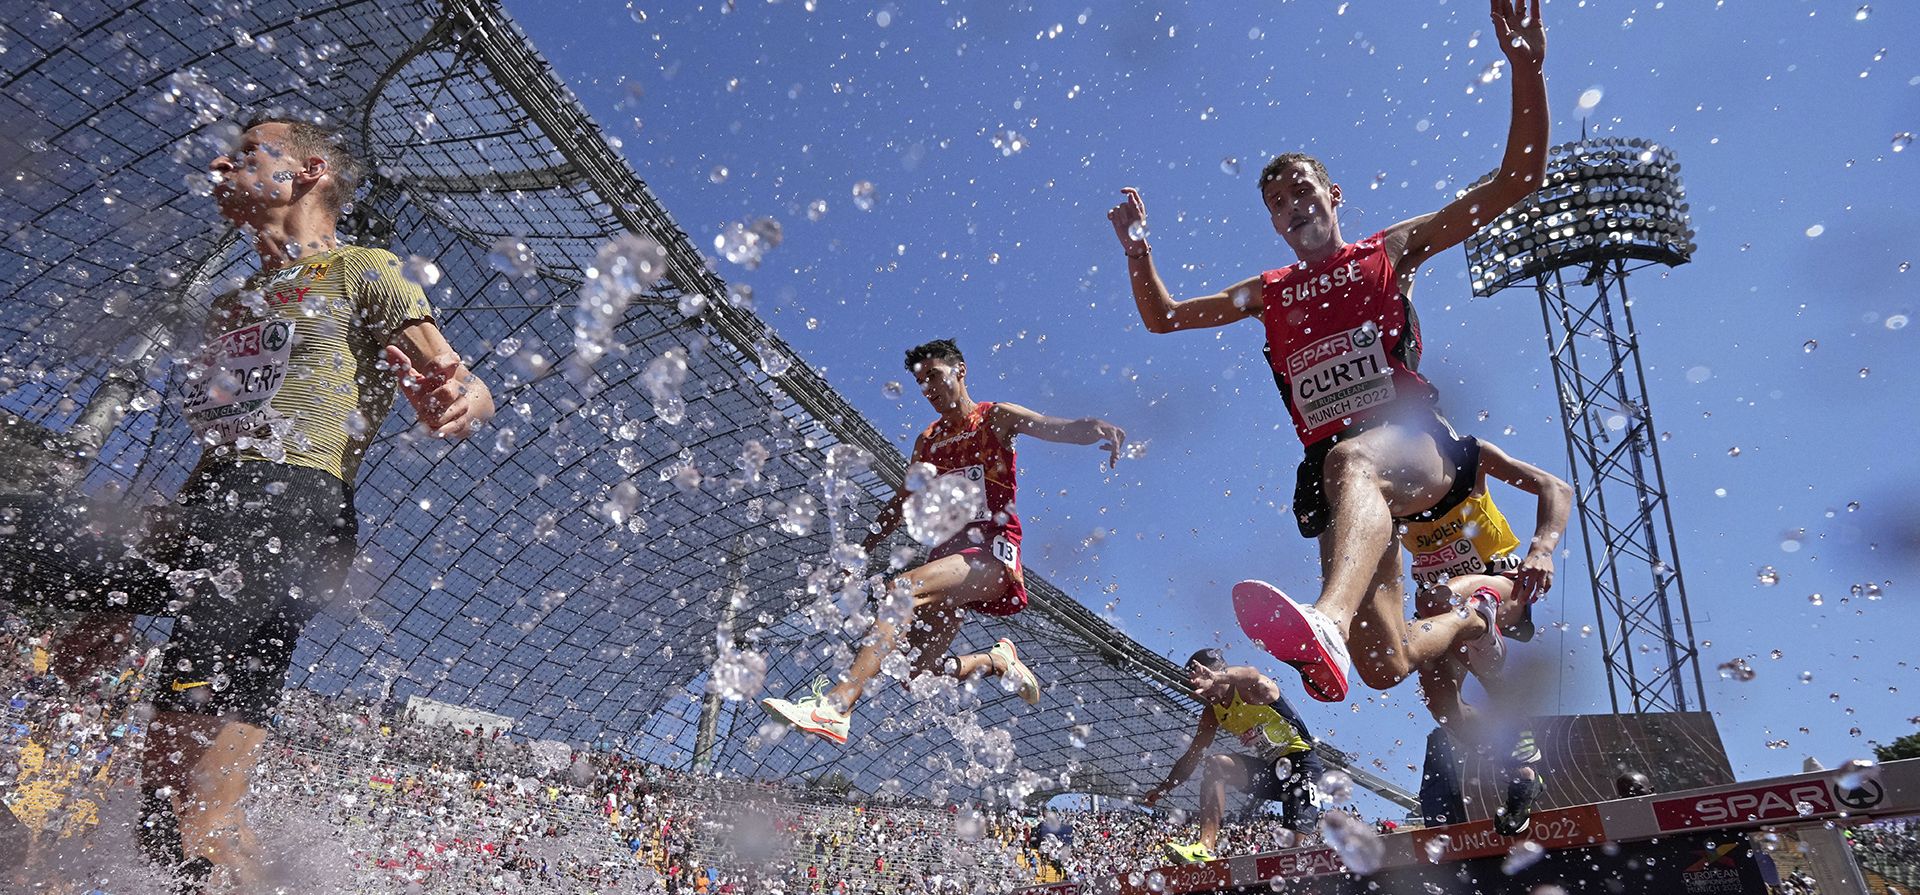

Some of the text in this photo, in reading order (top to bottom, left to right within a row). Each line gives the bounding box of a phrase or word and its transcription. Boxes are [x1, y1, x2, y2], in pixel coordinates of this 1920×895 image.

[1291, 335, 1350, 374] SPAR
[1299, 353, 1380, 400] CURTI
[1308, 388, 1390, 426] MUNICH 2022
[997, 541, 1014, 562] 13
[1696, 786, 1830, 821] SPAR
[1525, 820, 1579, 842] 2022
[1182, 870, 1217, 887] 2022
[1682, 869, 1740, 881] EUROPEAN
